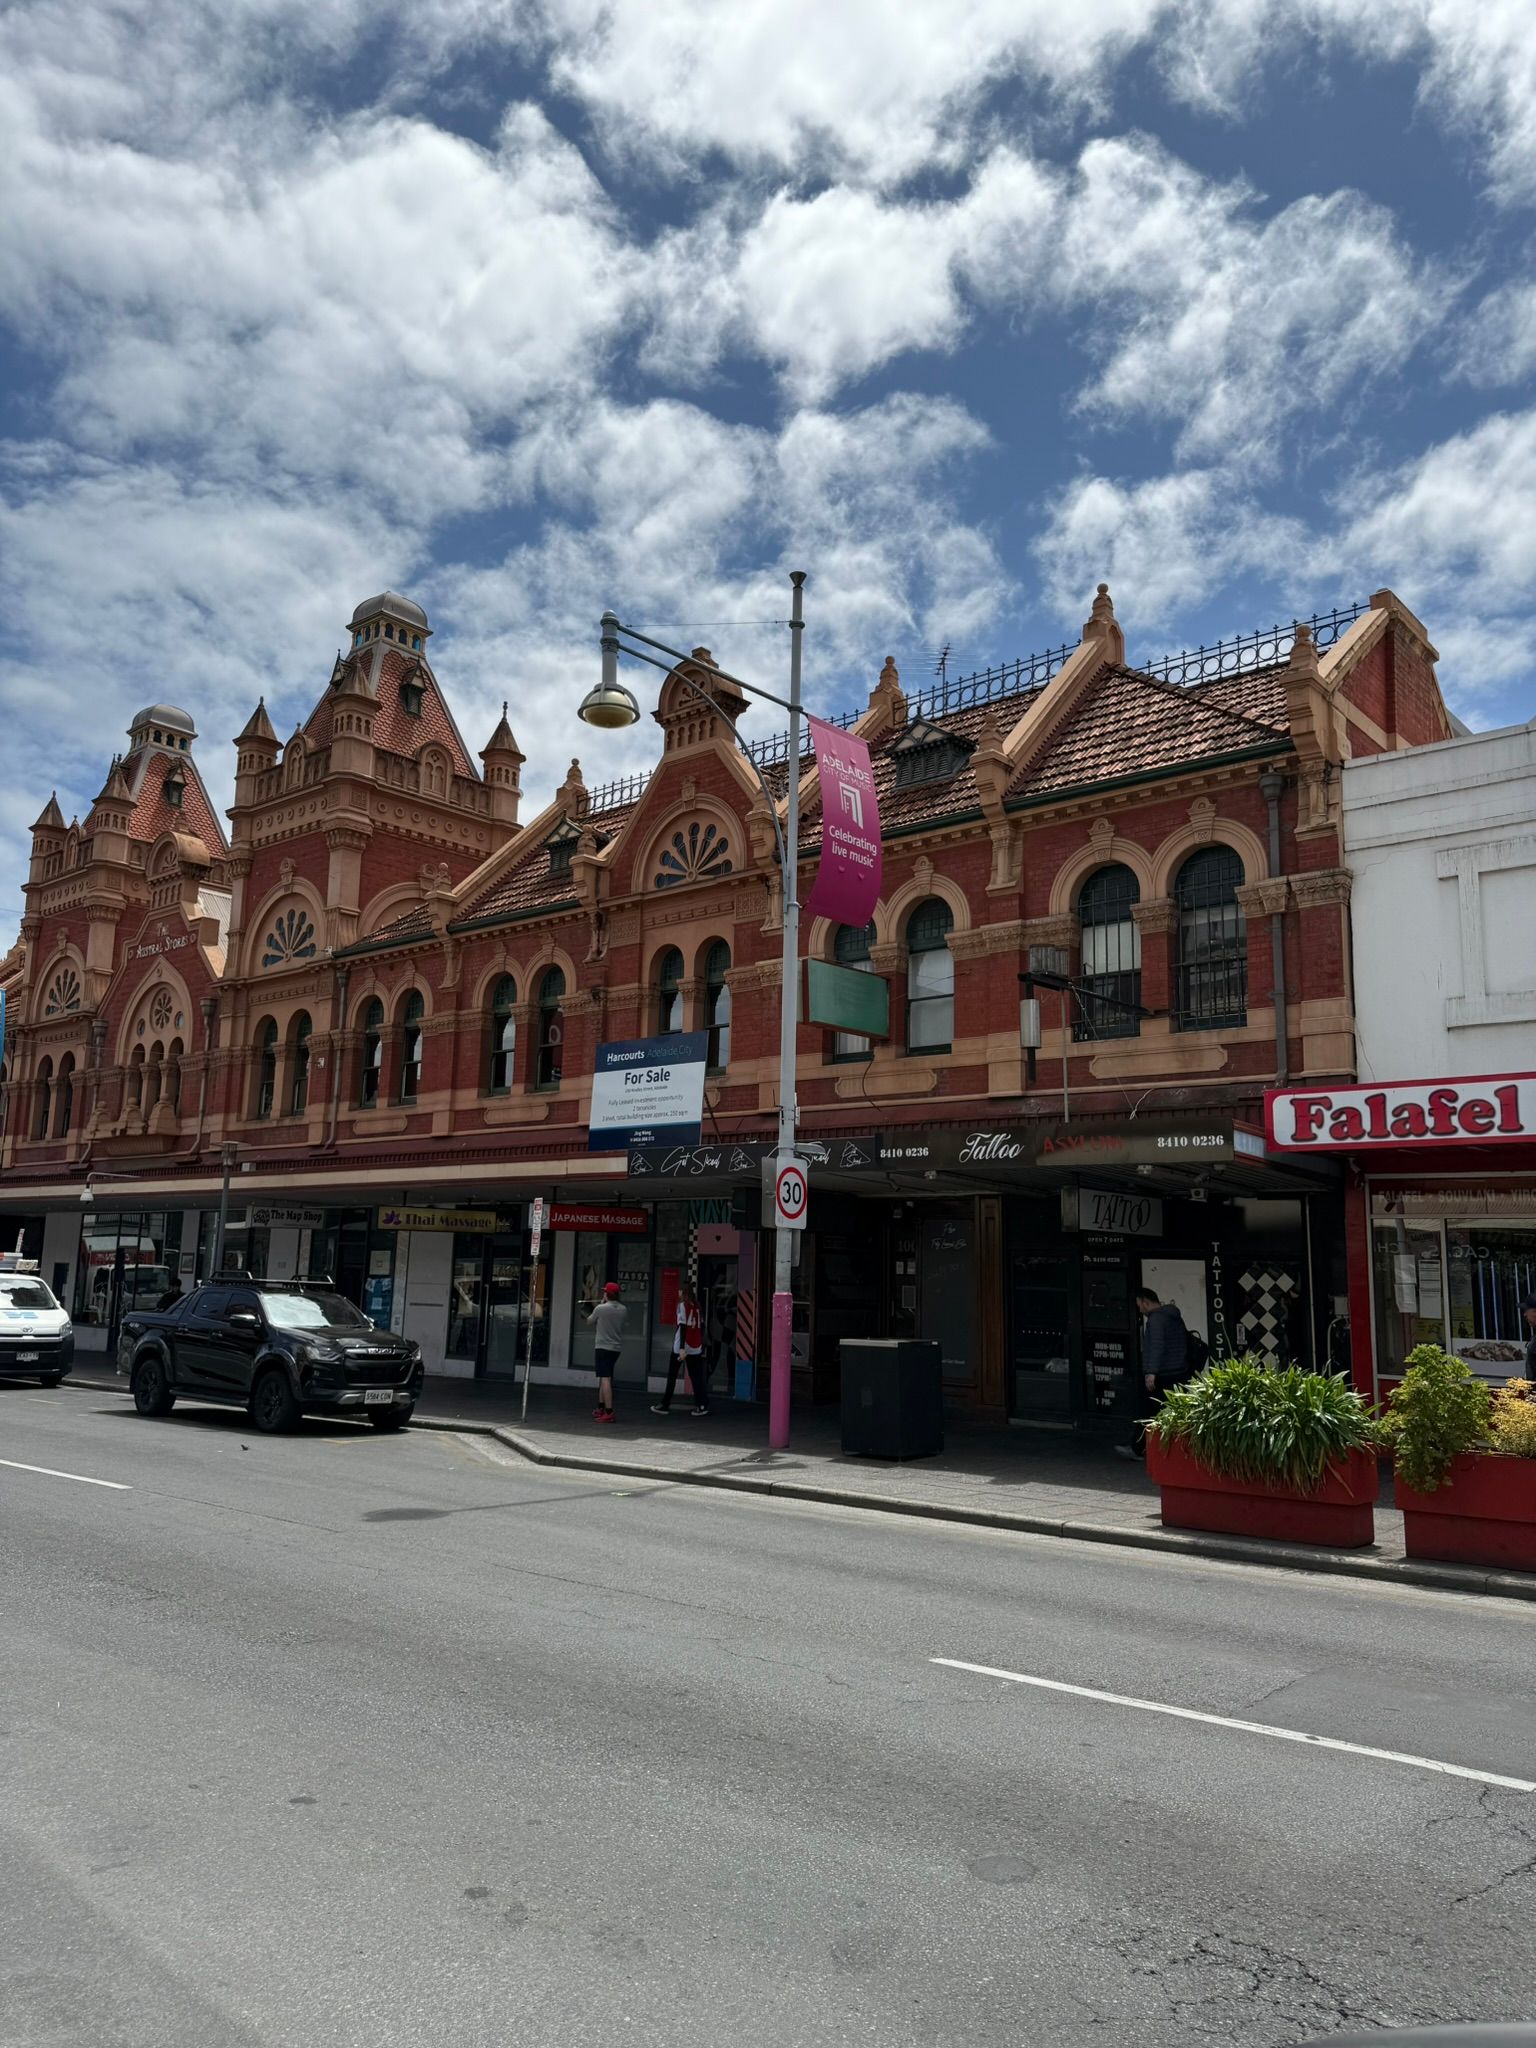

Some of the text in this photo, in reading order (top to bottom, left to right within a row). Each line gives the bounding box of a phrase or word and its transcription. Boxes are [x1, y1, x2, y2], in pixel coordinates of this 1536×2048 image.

[822, 753, 871, 784] ADELAIDE
[823, 764, 873, 793] CITY OF MUSIC
[829, 825, 877, 856] Celebrating
[832, 842, 874, 868] live music
[606, 1050, 645, 1063] Harcourts
[624, 1068, 671, 1085] For Sale
[1290, 1084, 1524, 1142] Falafel
[880, 1146, 929, 1158] 8410 0236
[958, 1132, 1025, 1163] Tattoo
[1157, 1134, 1225, 1148] 8410 0236
[782, 1180, 802, 1205] 30
[1378, 1190, 1422, 1202] FALAFEL
[1438, 1189, 1496, 1202] SOUVLAKI
[270, 1210, 285, 1220] The
[303, 1210, 322, 1224] Shop
[406, 1214, 435, 1226] Thai
[439, 1216, 492, 1228] Massage
[1092, 1194, 1150, 1232] TATTOO
[1212, 1242, 1224, 1324] TATTOO
